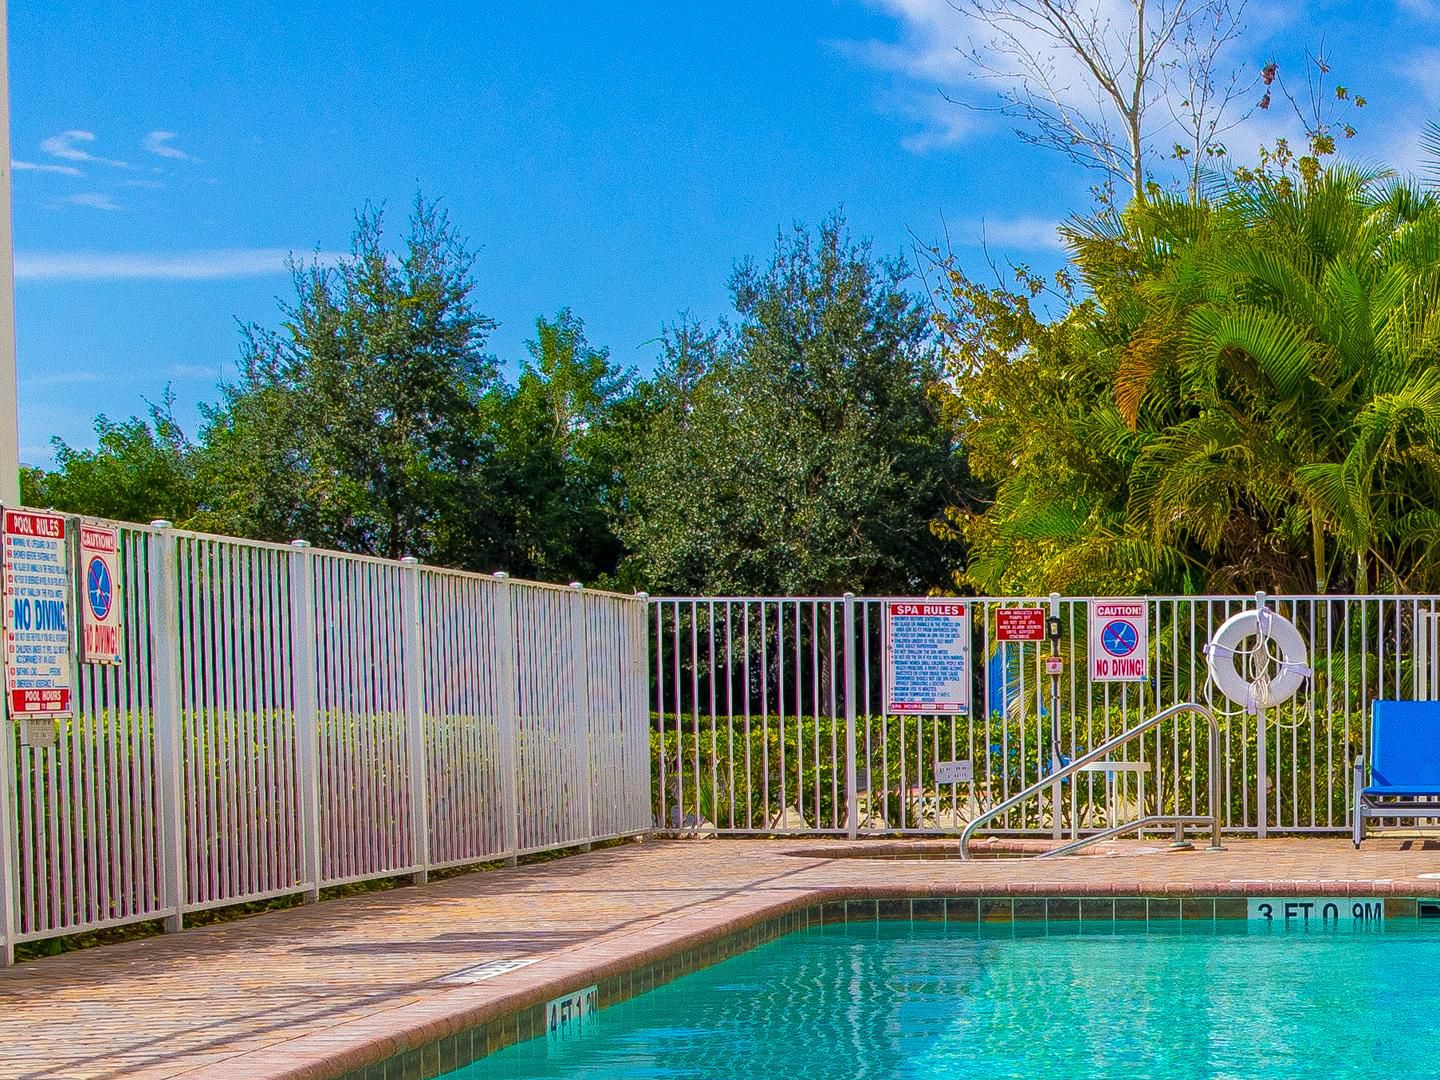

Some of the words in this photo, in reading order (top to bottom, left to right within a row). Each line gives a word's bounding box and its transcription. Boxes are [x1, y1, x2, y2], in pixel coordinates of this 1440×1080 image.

[14, 515, 33, 534] POOL
[36, 518, 60, 537] RULES
[82, 531, 114, 550] CAUTION!
[14, 599, 31, 631] NO
[897, 606, 919, 615] SPA
[924, 606, 959, 615] RULES
[1098, 607, 1142, 616] CAUTION!
[86, 623, 93, 653] NO
[94, 624, 117, 655] DIVING!
[1097, 659, 1108, 677] NO
[1112, 659, 1144, 677] DIVING!
[25, 691, 40, 701] POOL
[42, 691, 61, 701] HOURS
[1258, 902, 1274, 920] 3
[1284, 902, 1314, 920] FT
[561, 998, 573, 1022] FT
